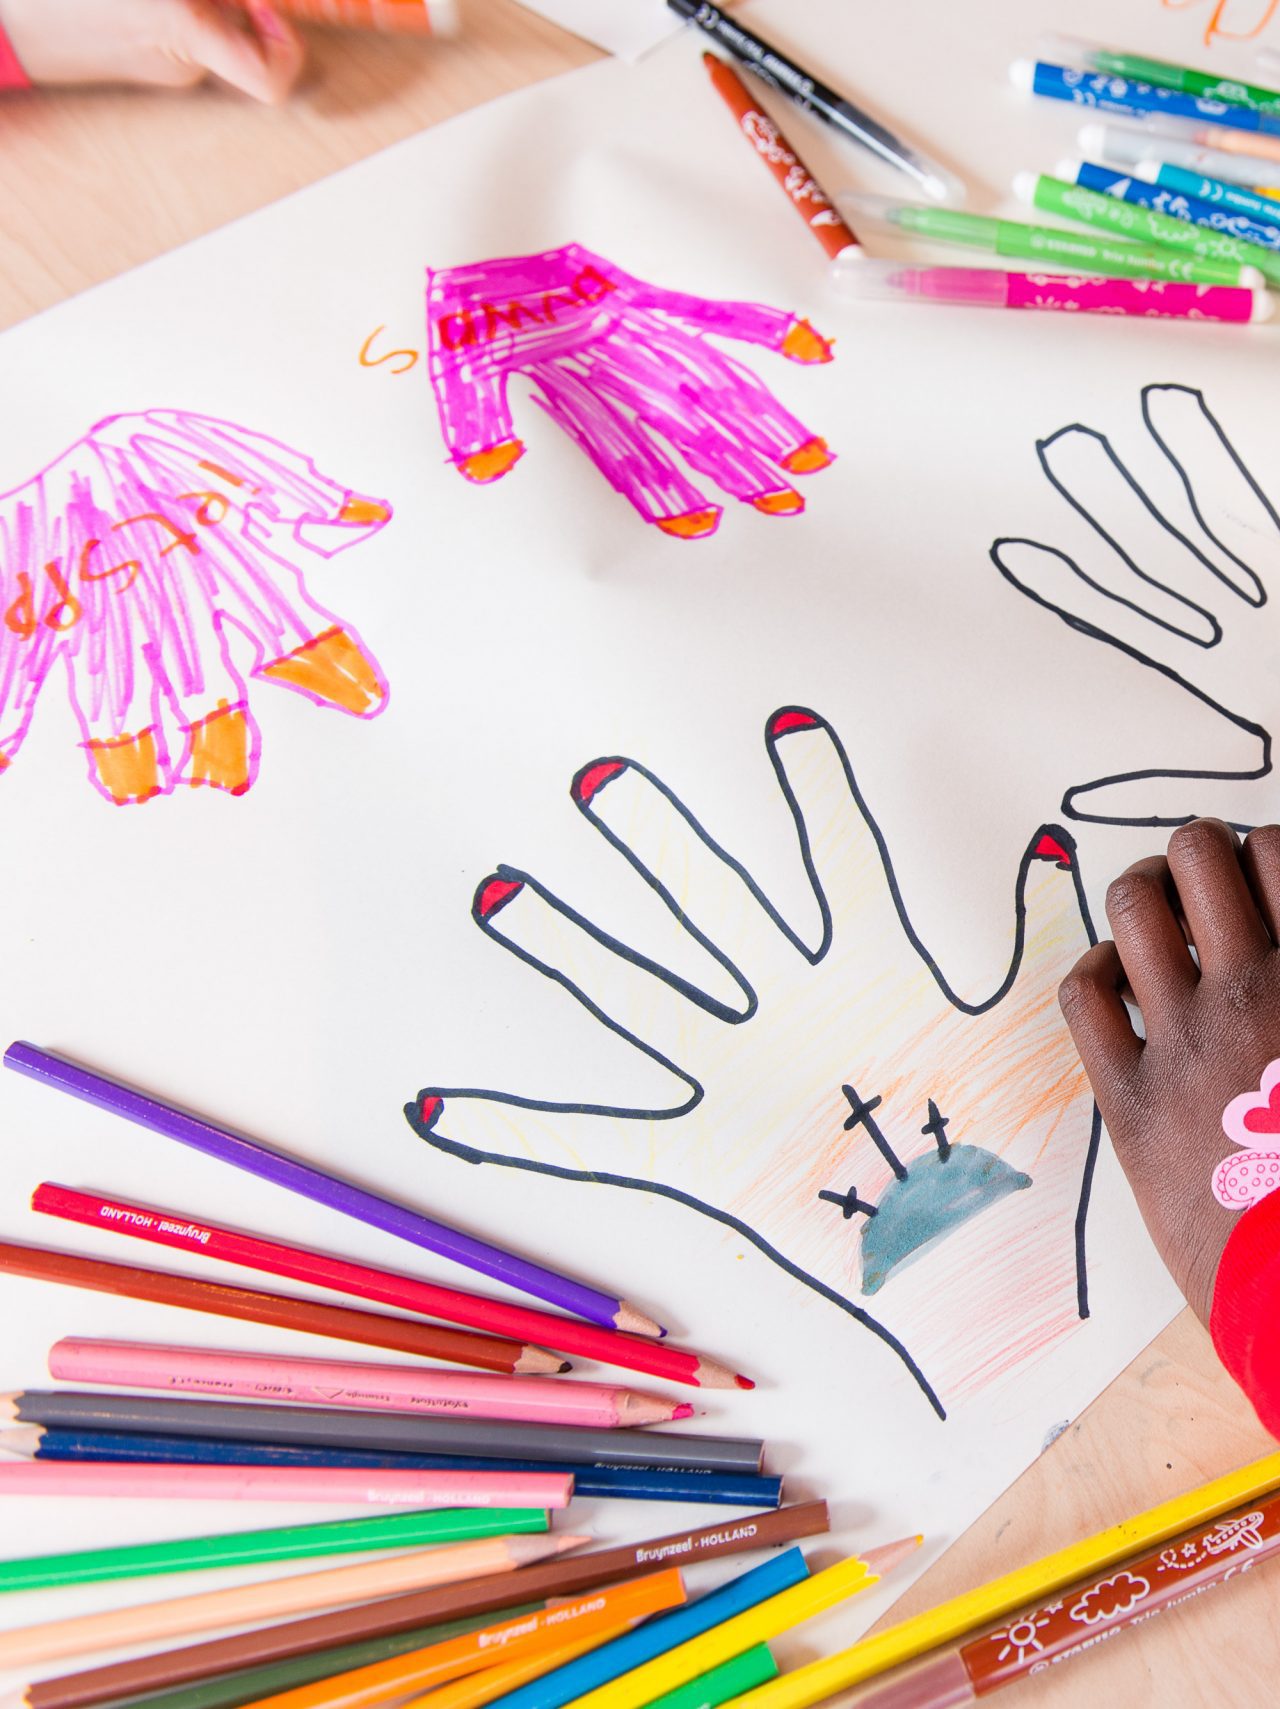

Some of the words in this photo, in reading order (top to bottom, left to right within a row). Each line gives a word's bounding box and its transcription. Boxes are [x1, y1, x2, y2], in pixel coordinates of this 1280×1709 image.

[100, 1206, 152, 1226] HOLLAND
[635, 1536, 694, 1564] Bruynzeel
[700, 1524, 758, 1547] HOLLAND
[546, 1596, 607, 1626] HOLLAND
